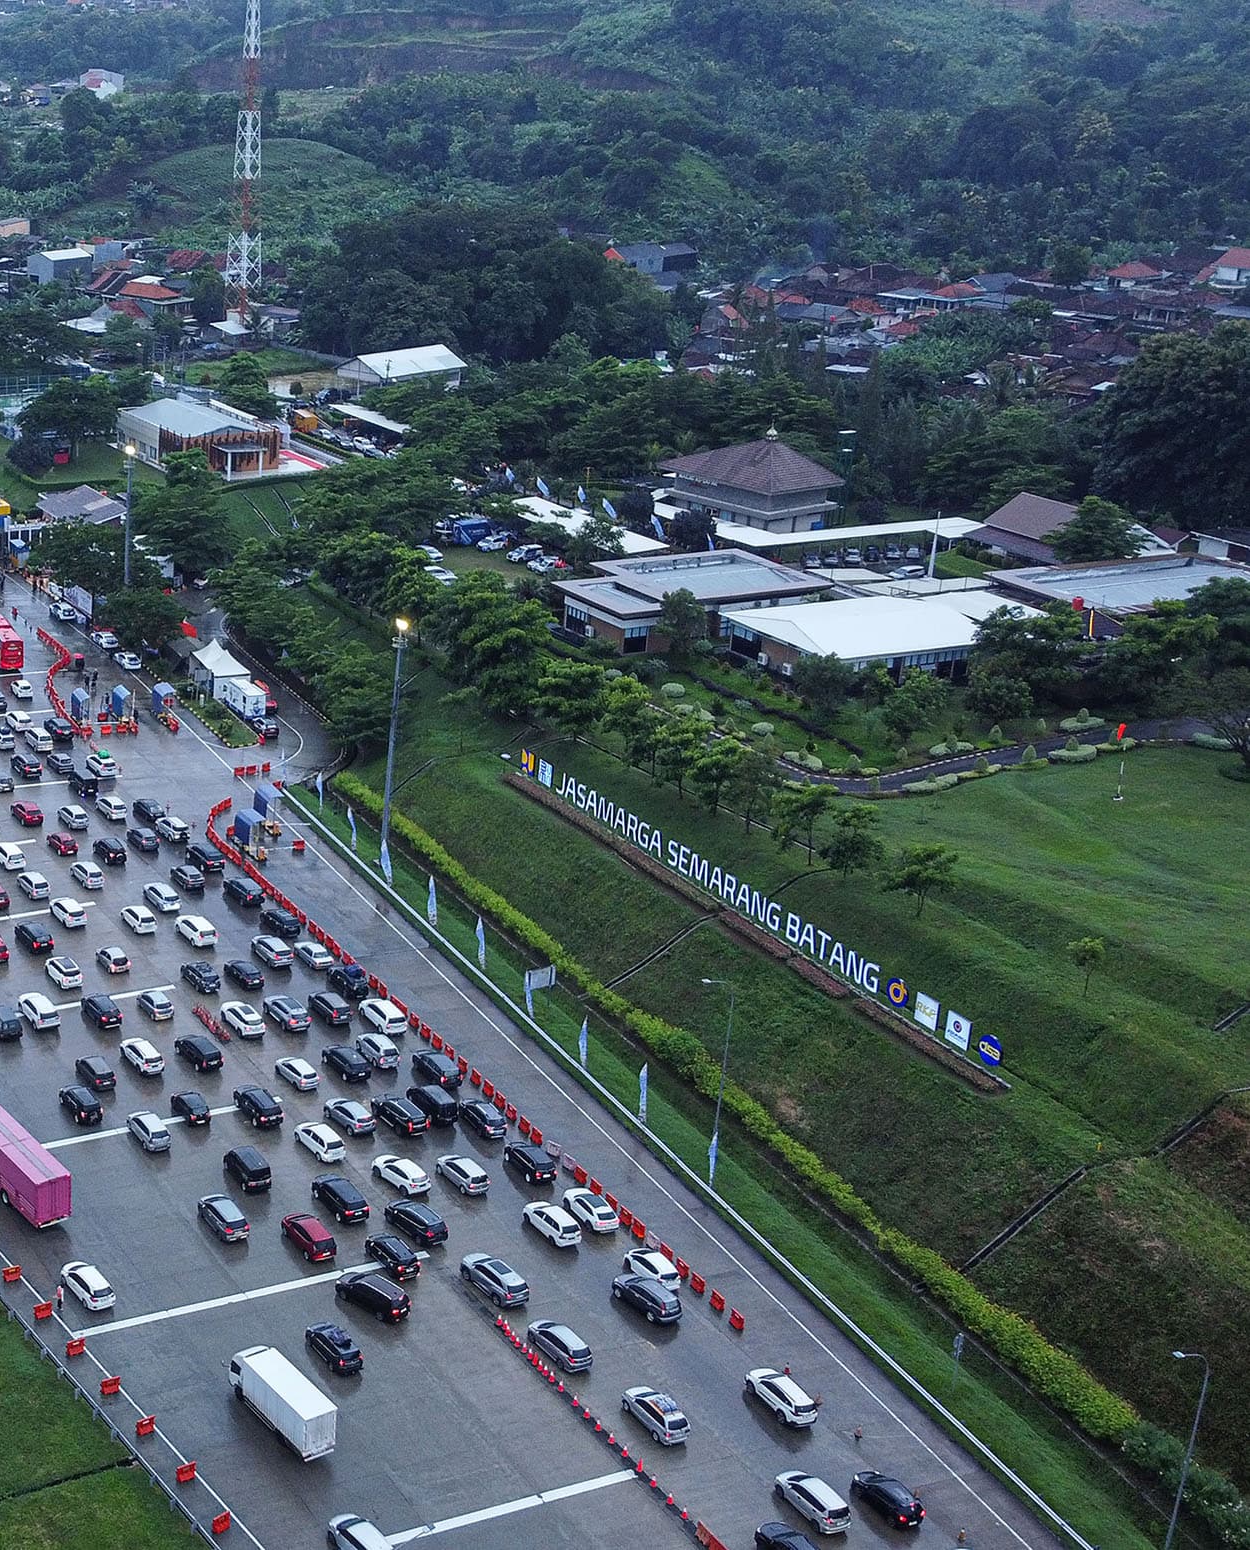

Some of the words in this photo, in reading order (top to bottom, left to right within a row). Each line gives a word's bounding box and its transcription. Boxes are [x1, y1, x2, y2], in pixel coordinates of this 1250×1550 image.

[555, 772, 662, 858] JASAMARGA
[667, 840, 781, 931] SEMARANG
[786, 912, 880, 993] BATANG
